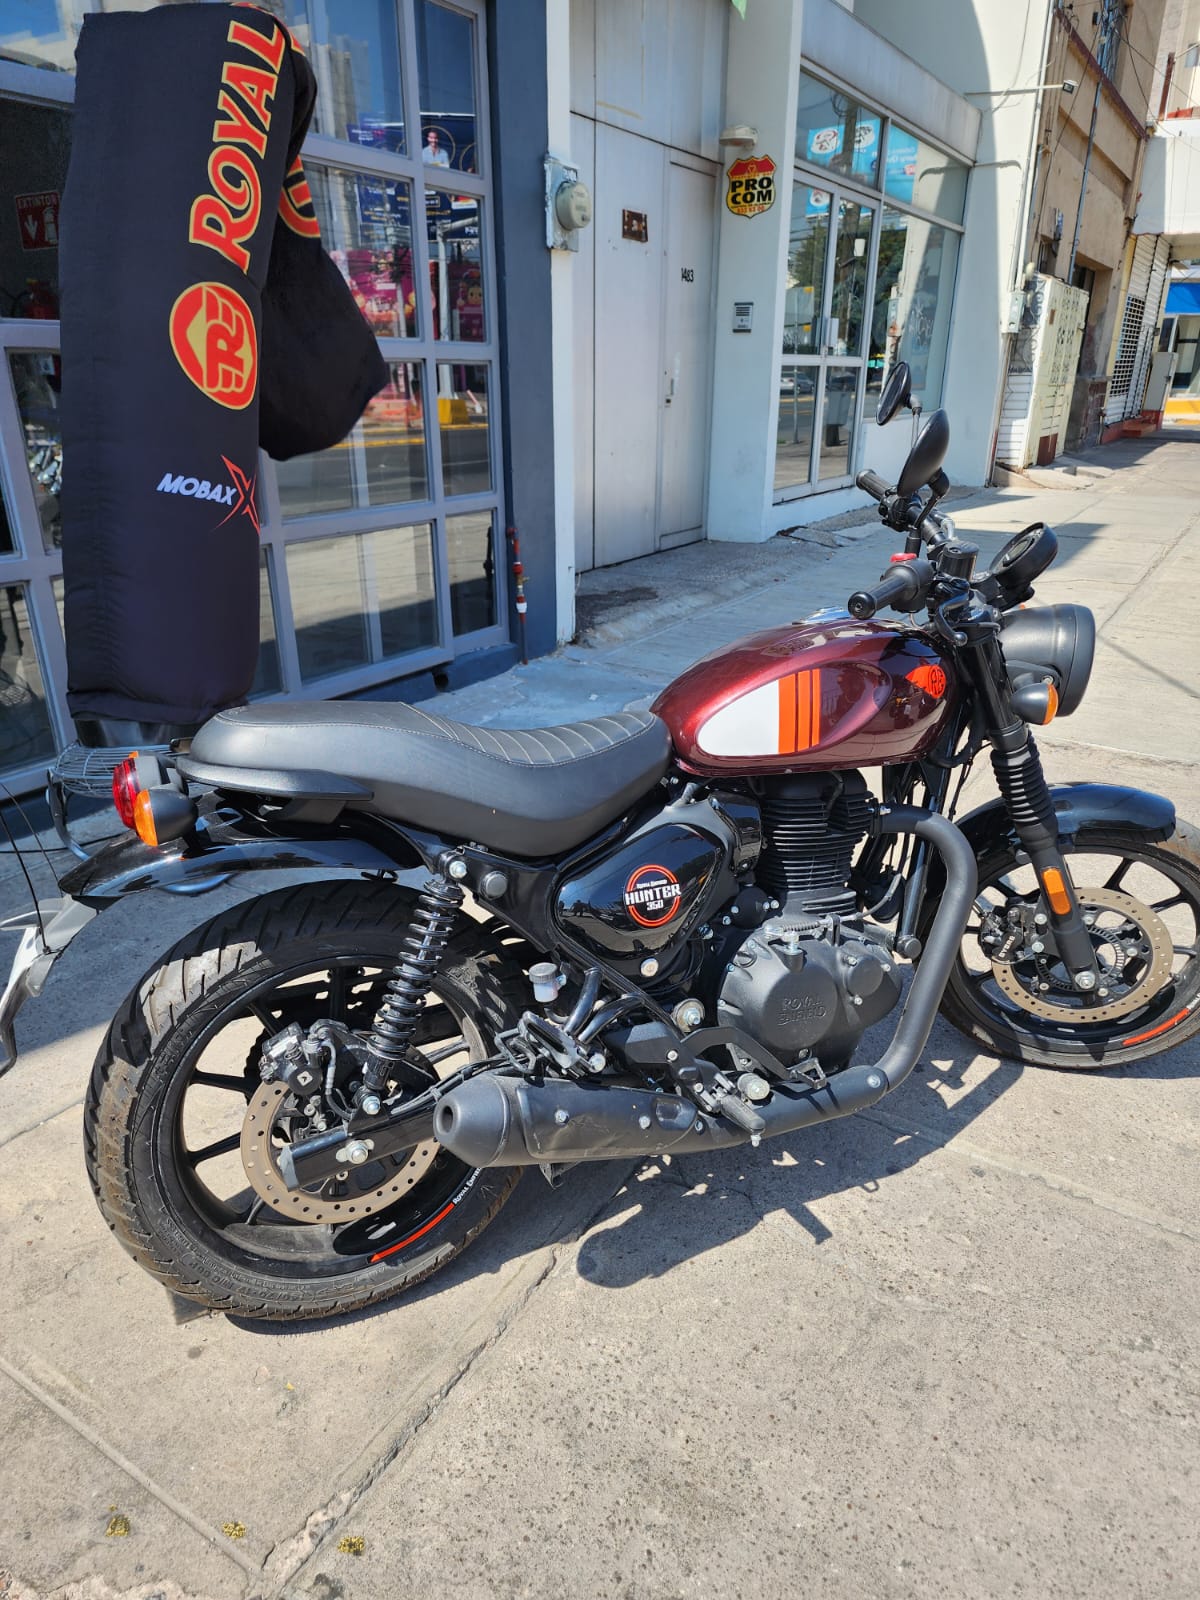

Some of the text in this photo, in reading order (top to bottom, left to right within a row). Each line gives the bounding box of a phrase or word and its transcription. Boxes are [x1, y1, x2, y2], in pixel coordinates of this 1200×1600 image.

[188, 18, 286, 274] ROYAL
[731, 177, 772, 192] PRO
[731, 190, 772, 204] COM
[681, 267, 695, 283] 1483
[625, 884, 681, 905] HUNTER
[647, 900, 664, 911] 350
